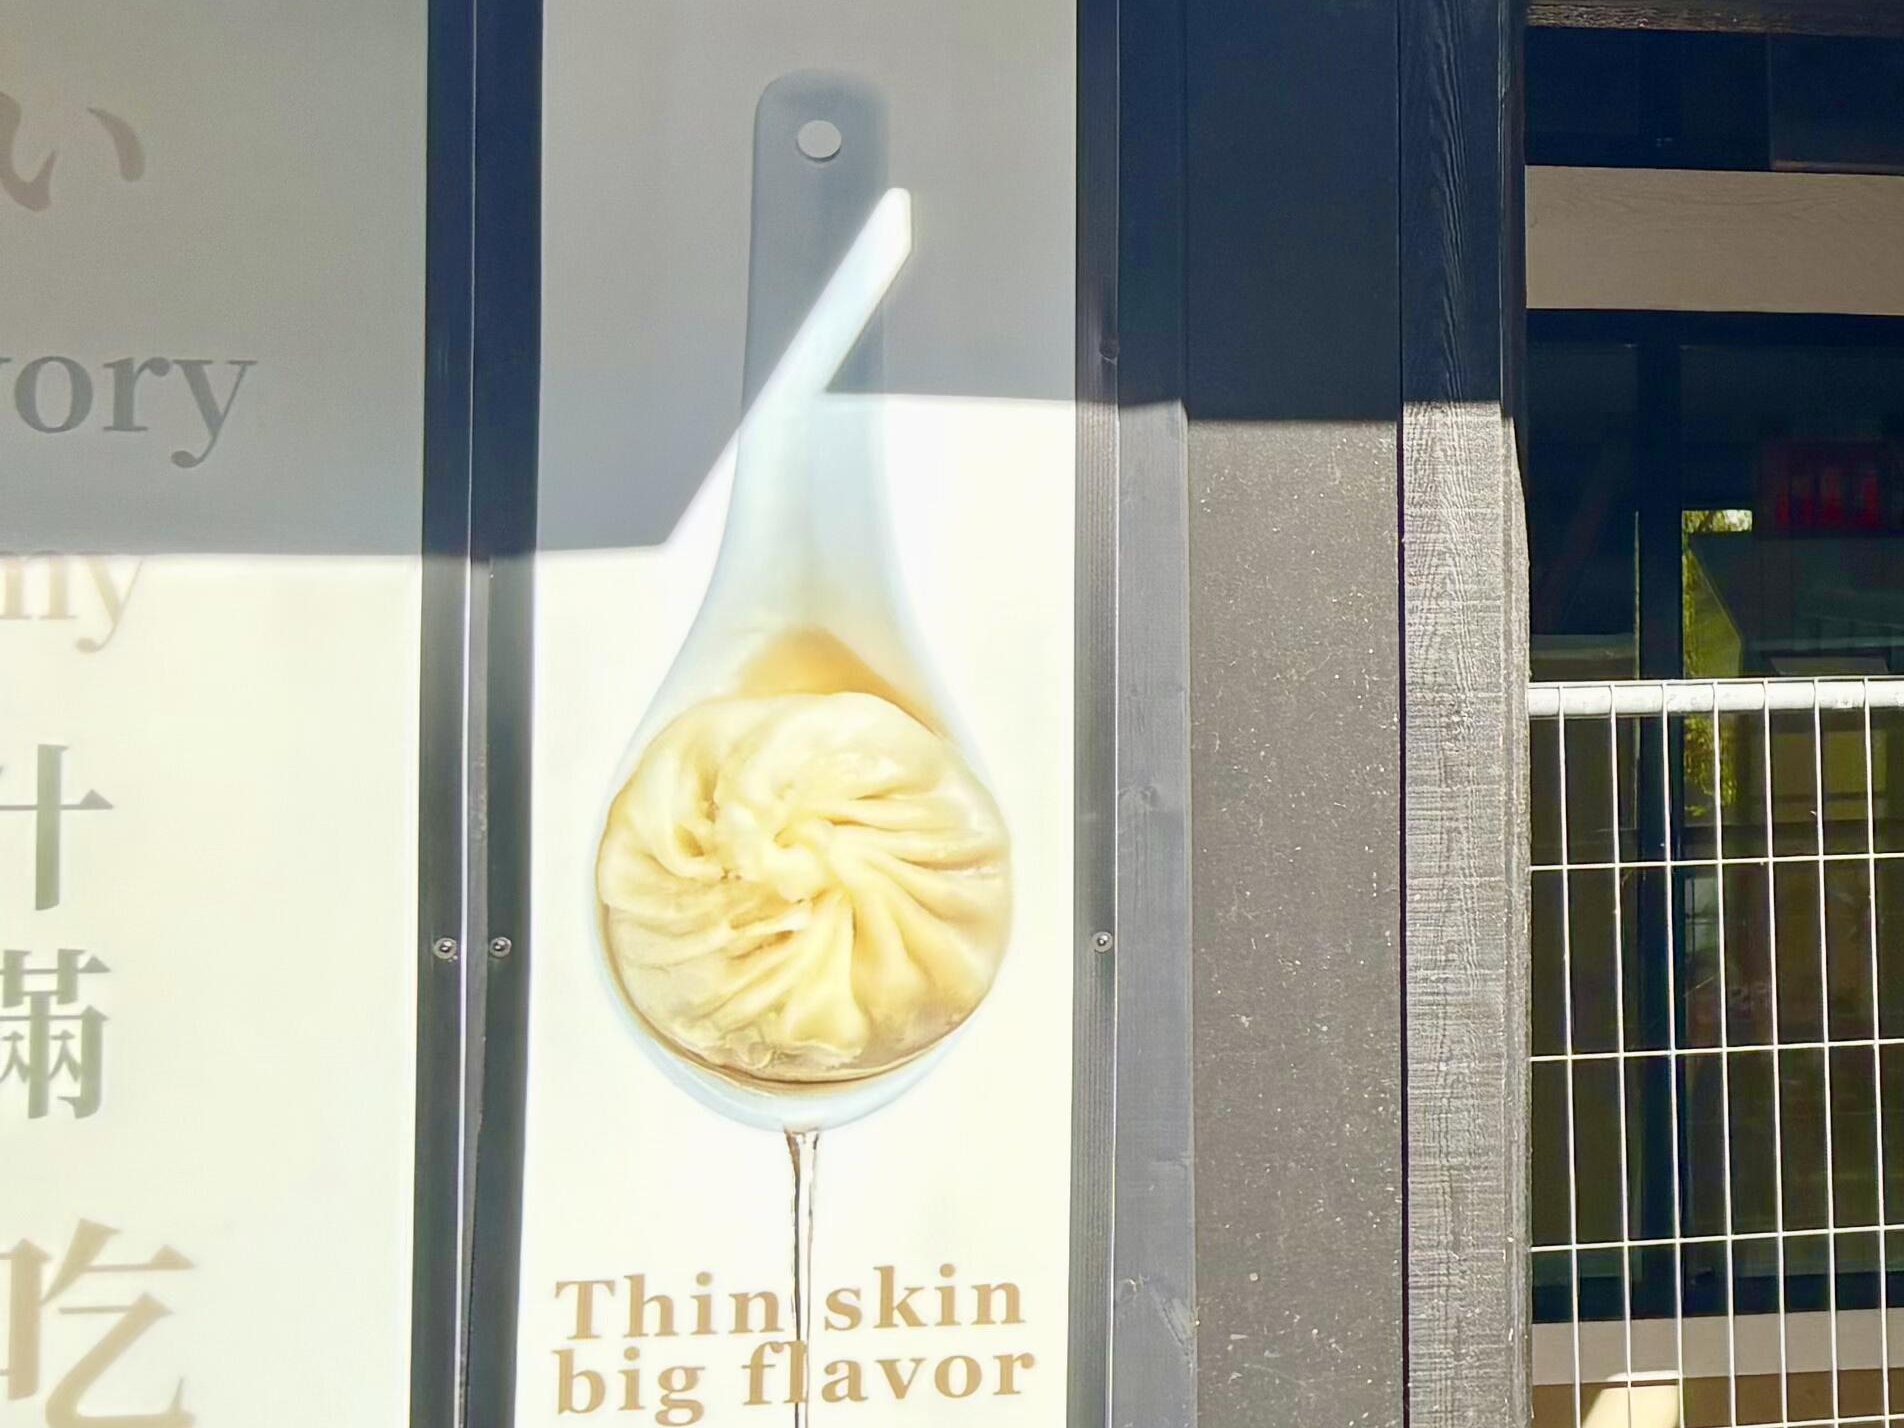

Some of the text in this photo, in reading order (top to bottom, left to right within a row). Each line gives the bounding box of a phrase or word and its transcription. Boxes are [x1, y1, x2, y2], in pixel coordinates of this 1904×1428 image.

[0, 355, 258, 469] ory
[554, 1263, 1026, 1340] Thin skin
[551, 1339, 1036, 1428] big flavor
